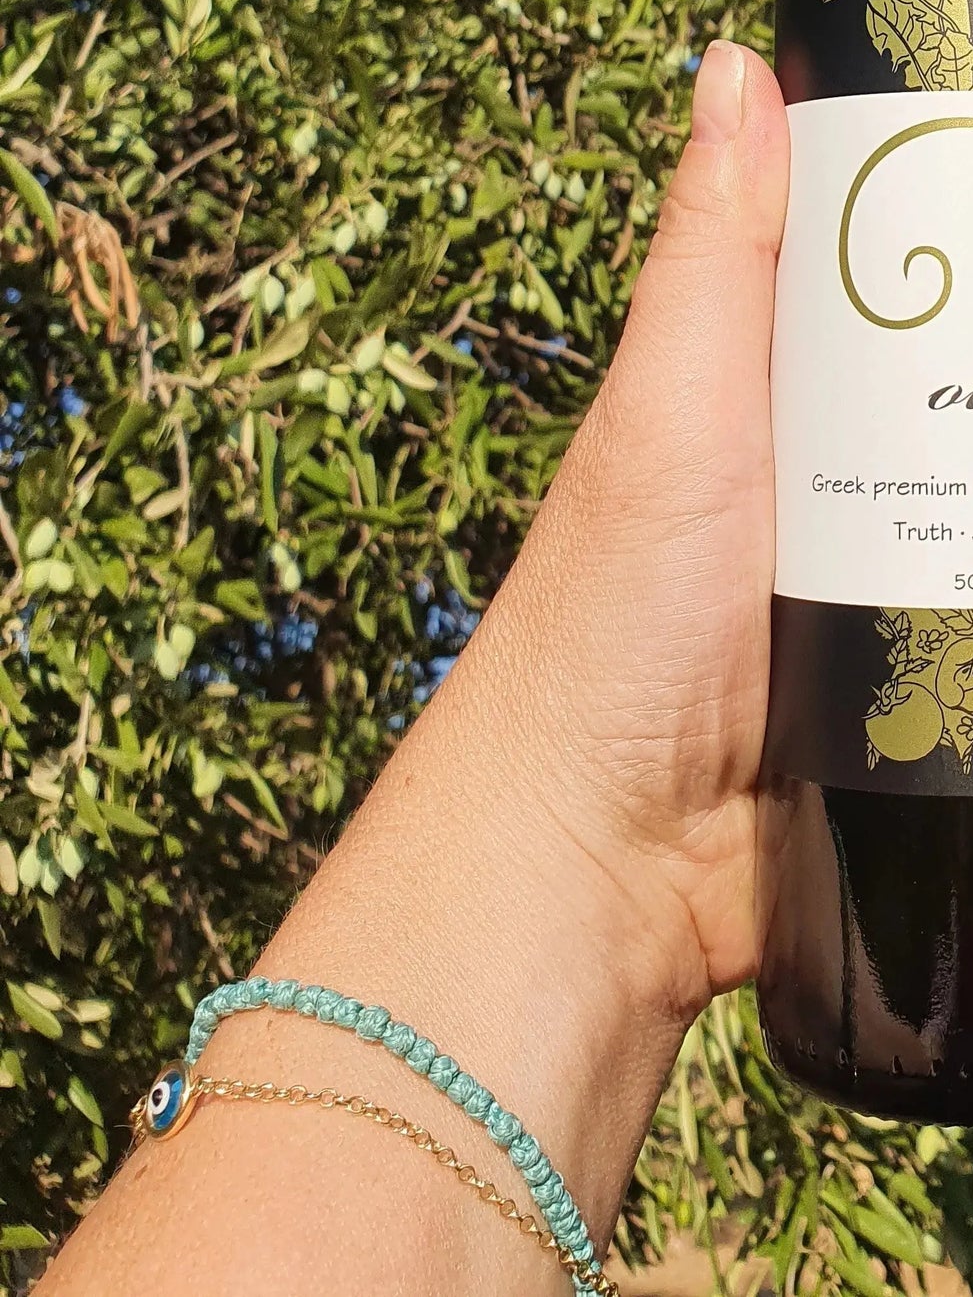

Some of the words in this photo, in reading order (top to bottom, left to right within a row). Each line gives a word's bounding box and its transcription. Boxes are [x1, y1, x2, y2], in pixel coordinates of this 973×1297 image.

[811, 473, 867, 495] Greek
[873, 474, 968, 502] premium
[892, 521, 953, 542] Truth
